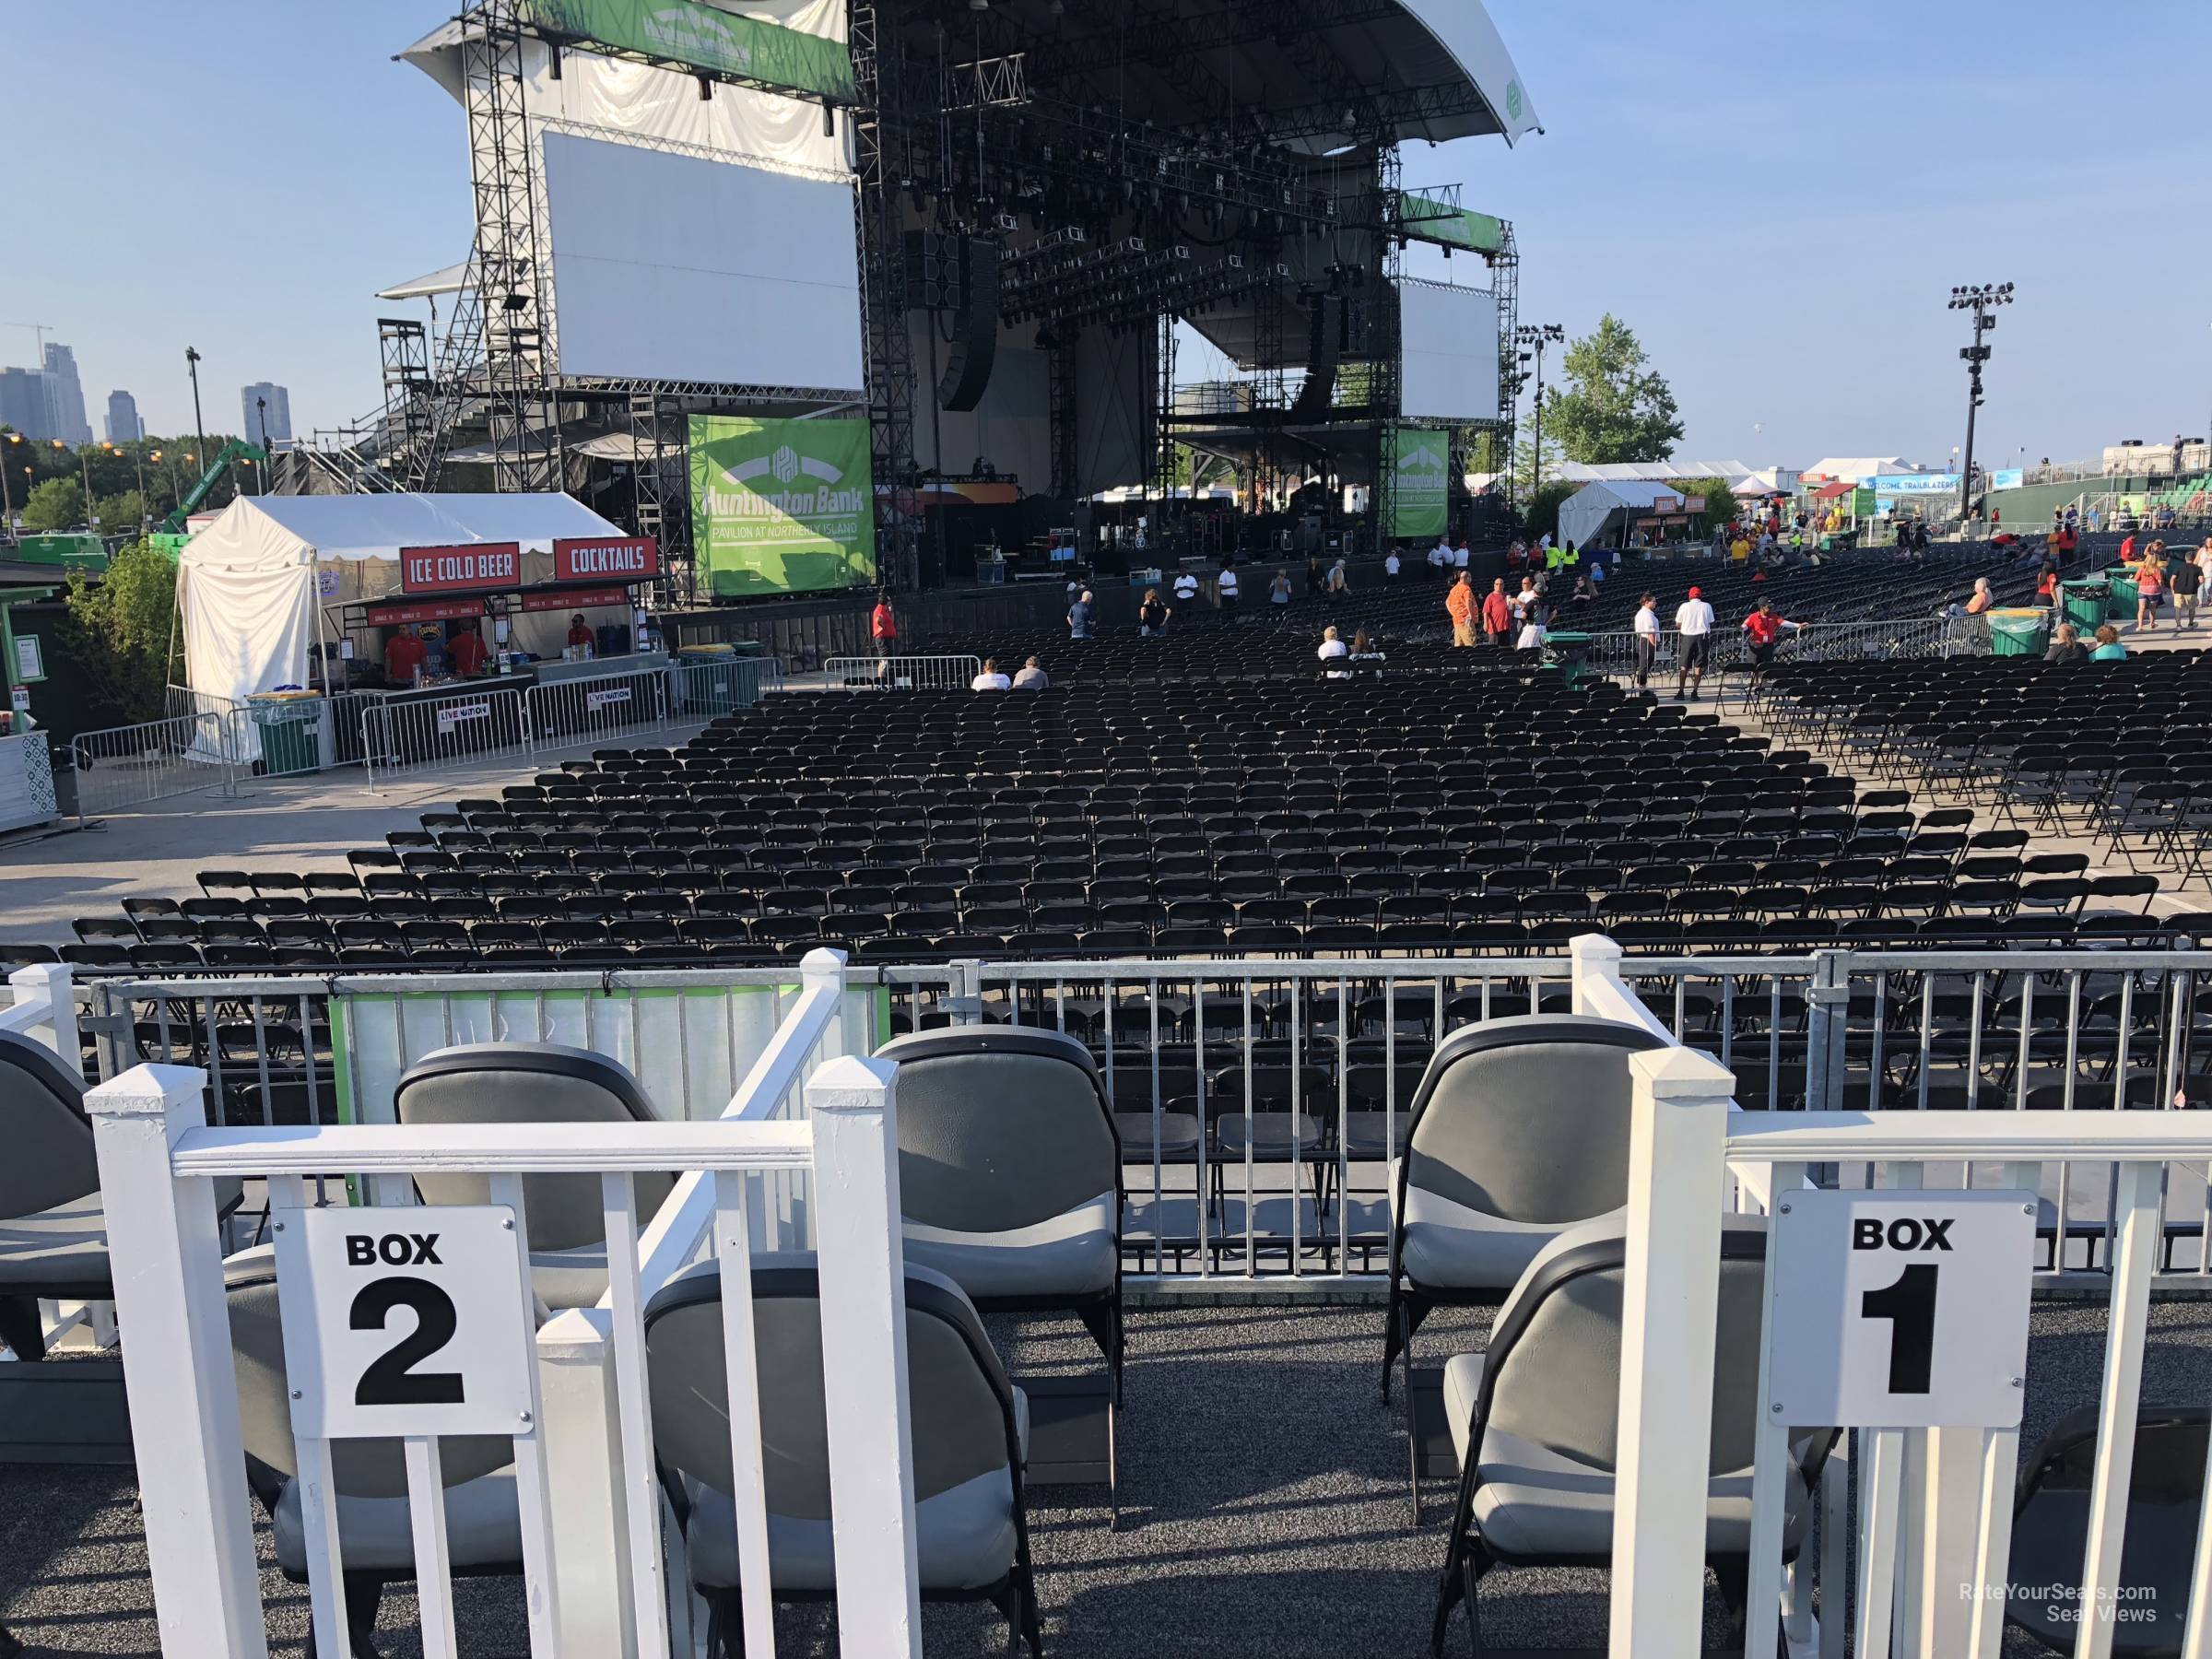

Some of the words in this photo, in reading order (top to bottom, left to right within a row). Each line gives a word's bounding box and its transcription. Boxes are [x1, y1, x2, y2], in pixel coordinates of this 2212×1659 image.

[702, 486, 815, 524] Huntington
[818, 486, 864, 513] Bank
[712, 526, 753, 539] PAVILION
[755, 525, 766, 537] AT
[767, 524, 819, 537] NORTHERLY
[823, 523, 857, 535] ISLAND
[410, 558, 432, 583] ICE
[437, 556, 475, 581] COLD
[477, 553, 512, 579] BEER
[571, 546, 644, 573] COCKTAILS
[441, 710, 458, 721] LIVE
[460, 705, 487, 717] NATION
[346, 1233, 443, 1265] BOX
[1853, 1218, 1956, 1251] BOX
[349, 1276, 465, 1406] 2
[1862, 1264, 1938, 1394] 1
